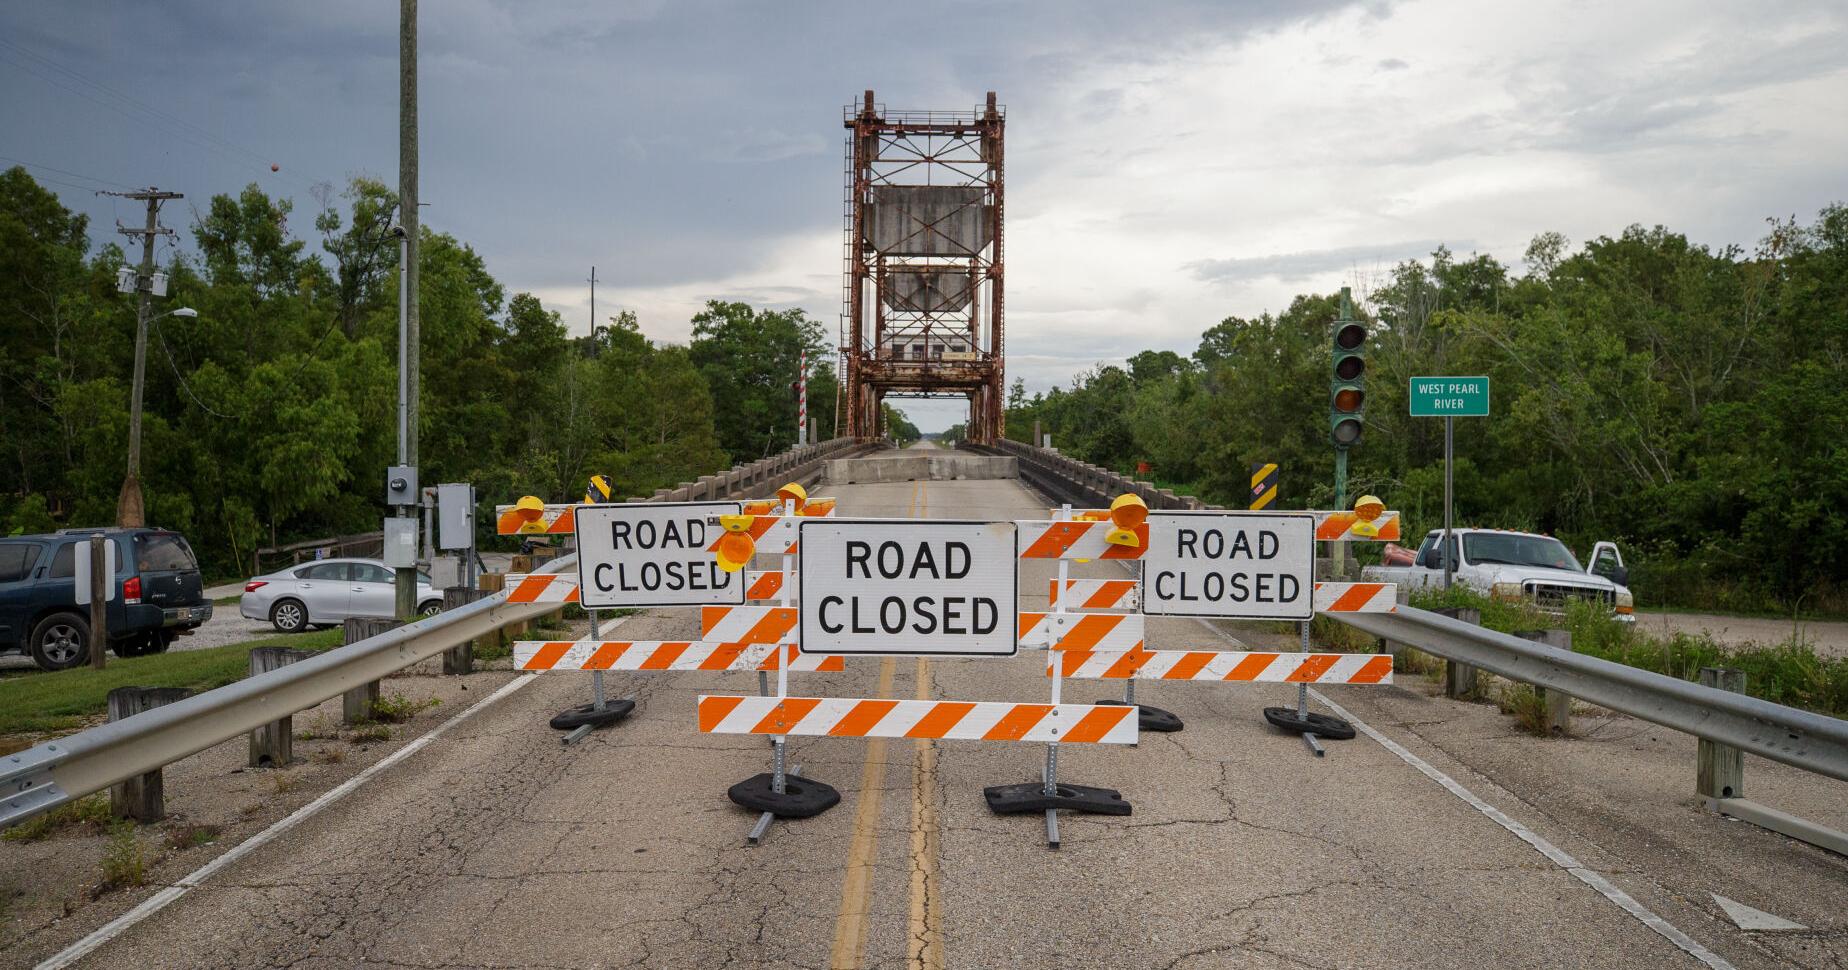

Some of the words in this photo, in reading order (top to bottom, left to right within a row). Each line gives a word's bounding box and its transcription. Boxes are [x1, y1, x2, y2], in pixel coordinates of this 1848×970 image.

[1418, 384, 1445, 394] WEST
[1449, 384, 1480, 394] PEARL
[1434, 399, 1464, 409] RIVER
[611, 519, 705, 550] ROAD
[1177, 528, 1280, 560] ROAD
[846, 540, 972, 580] ROAD
[594, 561, 731, 592] CLOSED
[1155, 570, 1300, 604] CLOSED
[818, 595, 999, 635] CLOSED
